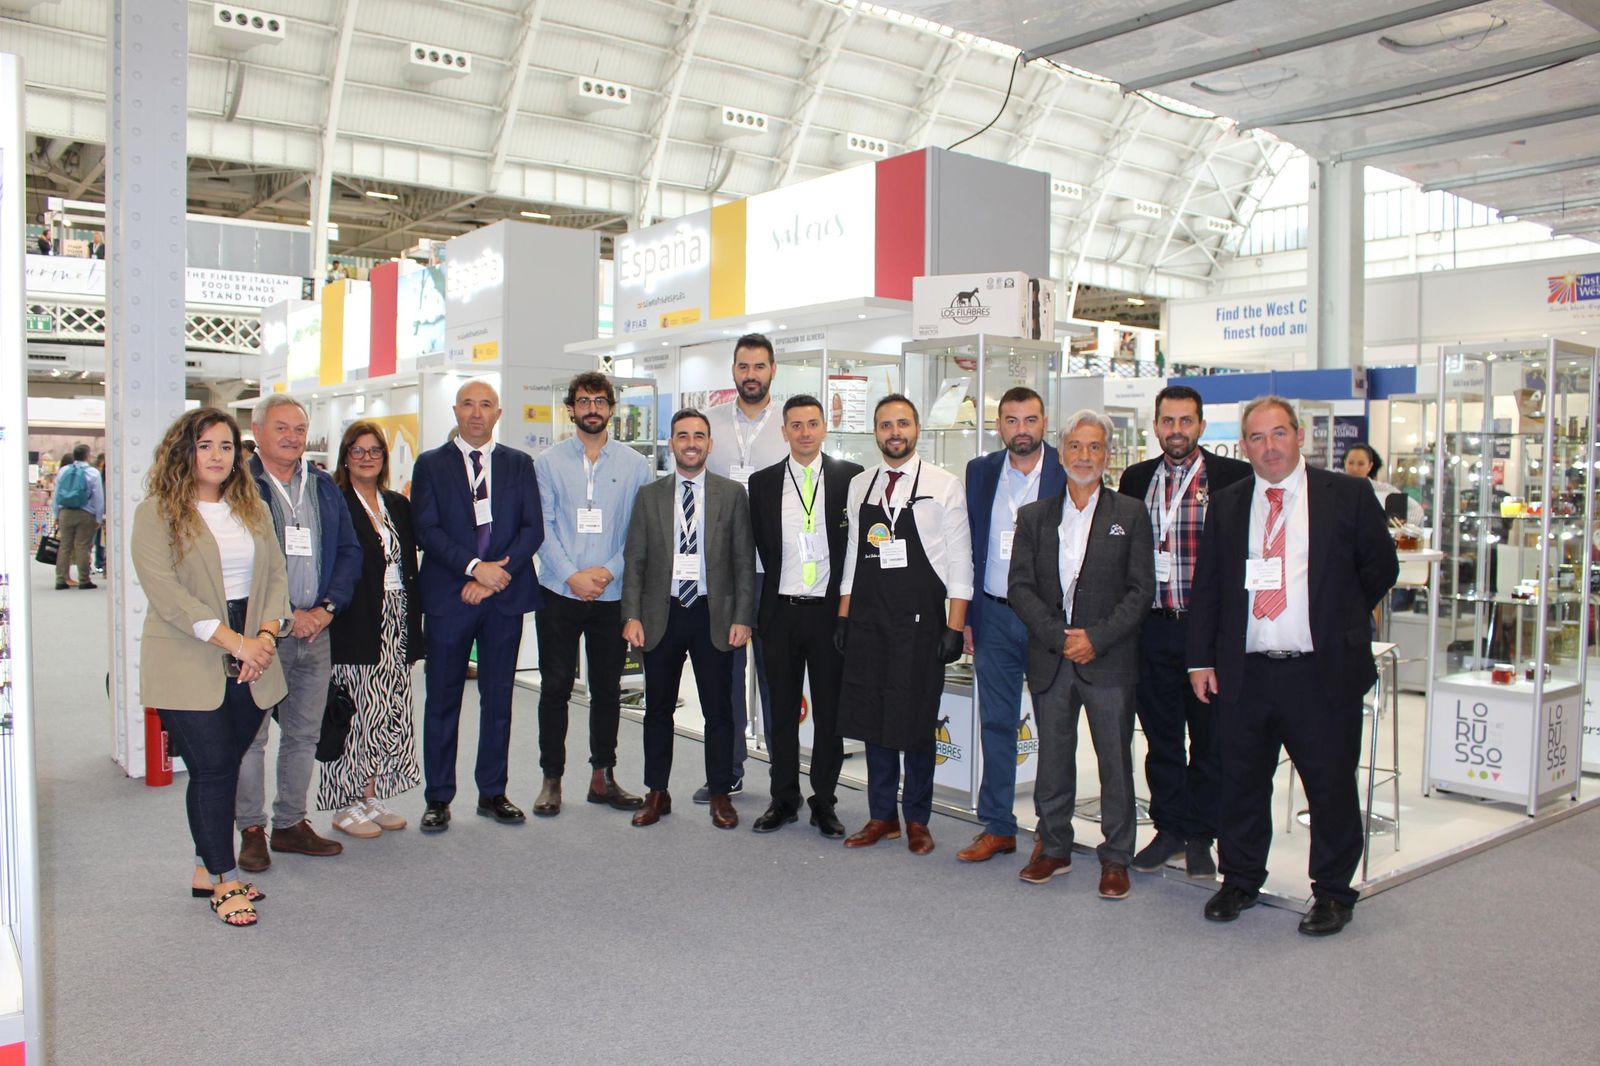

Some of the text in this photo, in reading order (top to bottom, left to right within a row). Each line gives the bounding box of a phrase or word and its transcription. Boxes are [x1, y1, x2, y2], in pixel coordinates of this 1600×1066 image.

[620, 228, 702, 289] España
[187, 271, 290, 286] THE FINEST ITALIAN
[201, 281, 276, 294] FOOD BRANDS
[202, 291, 275, 303] STAND 1460
[941, 307, 991, 318] LOS FILABRES
[1216, 299, 1308, 321] Find the West C
[631, 319, 647, 329] FIAB
[1223, 325, 1256, 340] finest
[1260, 321, 1286, 337] food
[936, 742, 962, 760] ABRES
[1017, 740, 1039, 753] ABRE
